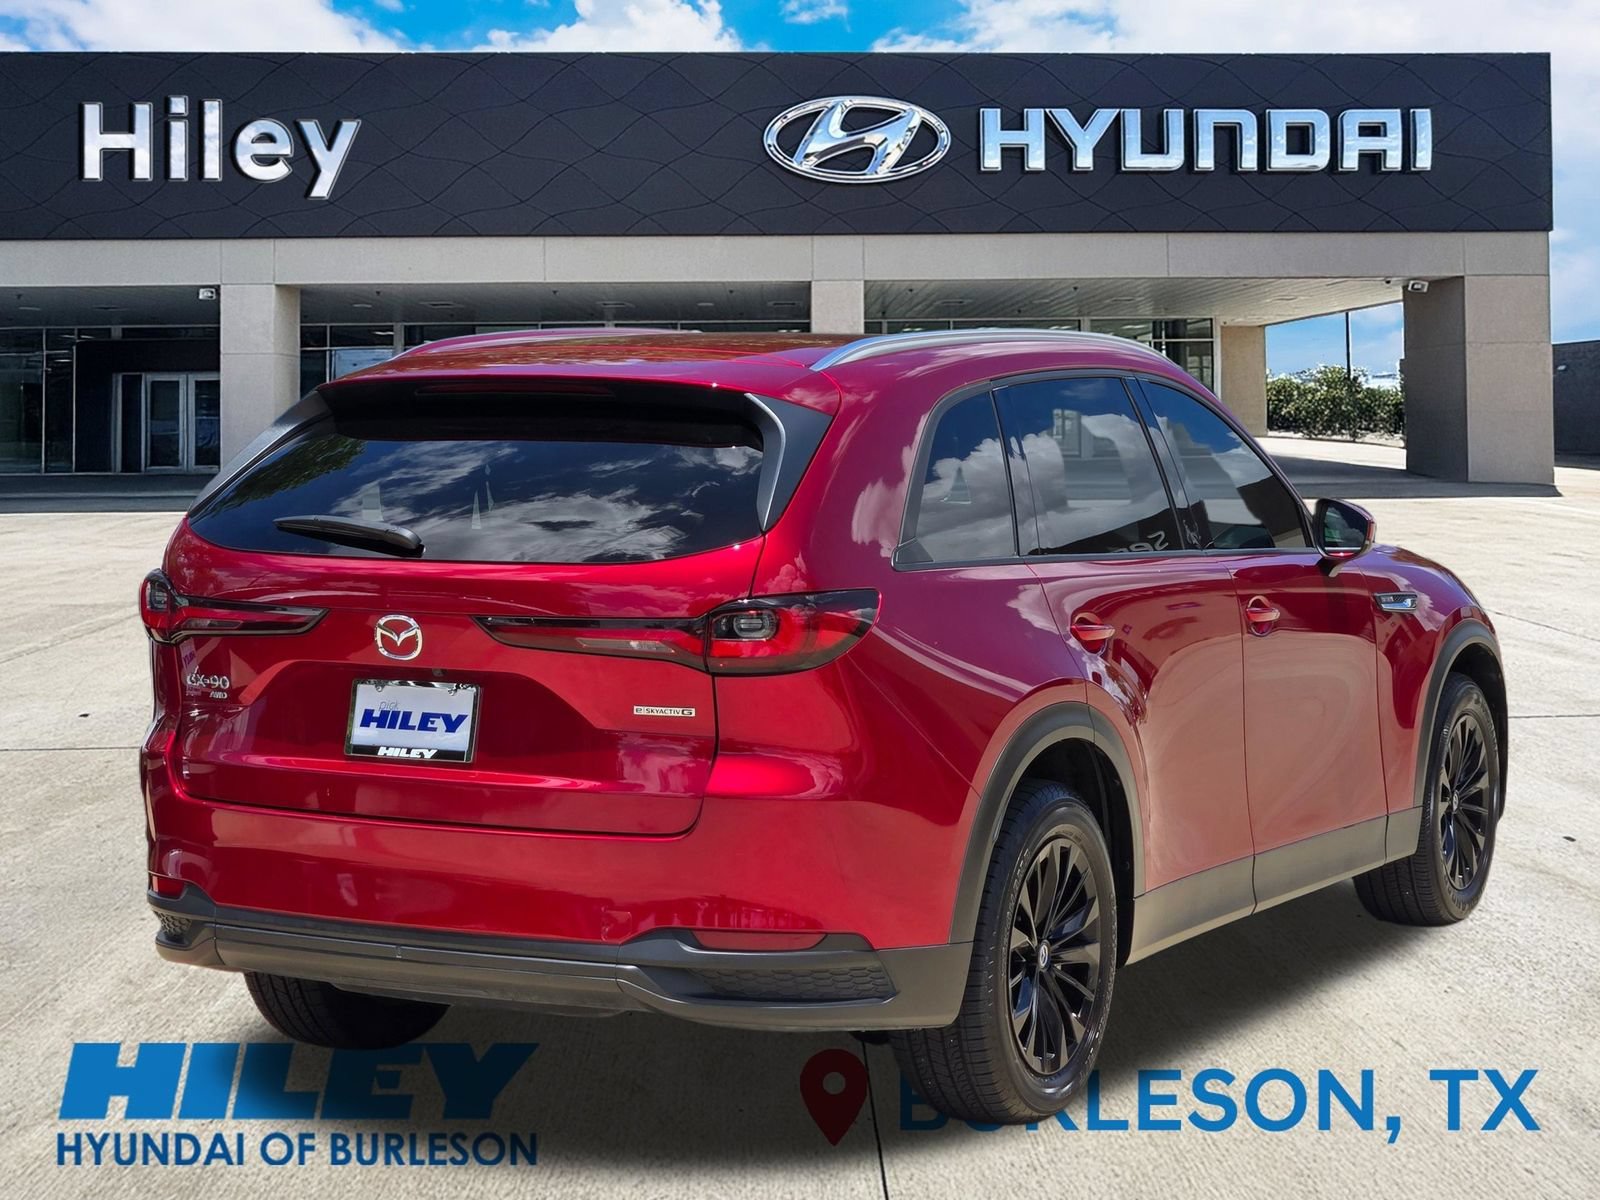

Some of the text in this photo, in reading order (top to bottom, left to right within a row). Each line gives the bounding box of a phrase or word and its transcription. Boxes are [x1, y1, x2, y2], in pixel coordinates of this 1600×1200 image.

[79, 95, 361, 200] Hiley
[979, 107, 1433, 173] HYUNDAI
[186, 673, 230, 690] CX-90
[209, 691, 228, 699] AWD
[360, 708, 469, 734] HILEY
[377, 746, 438, 759] HILEY
